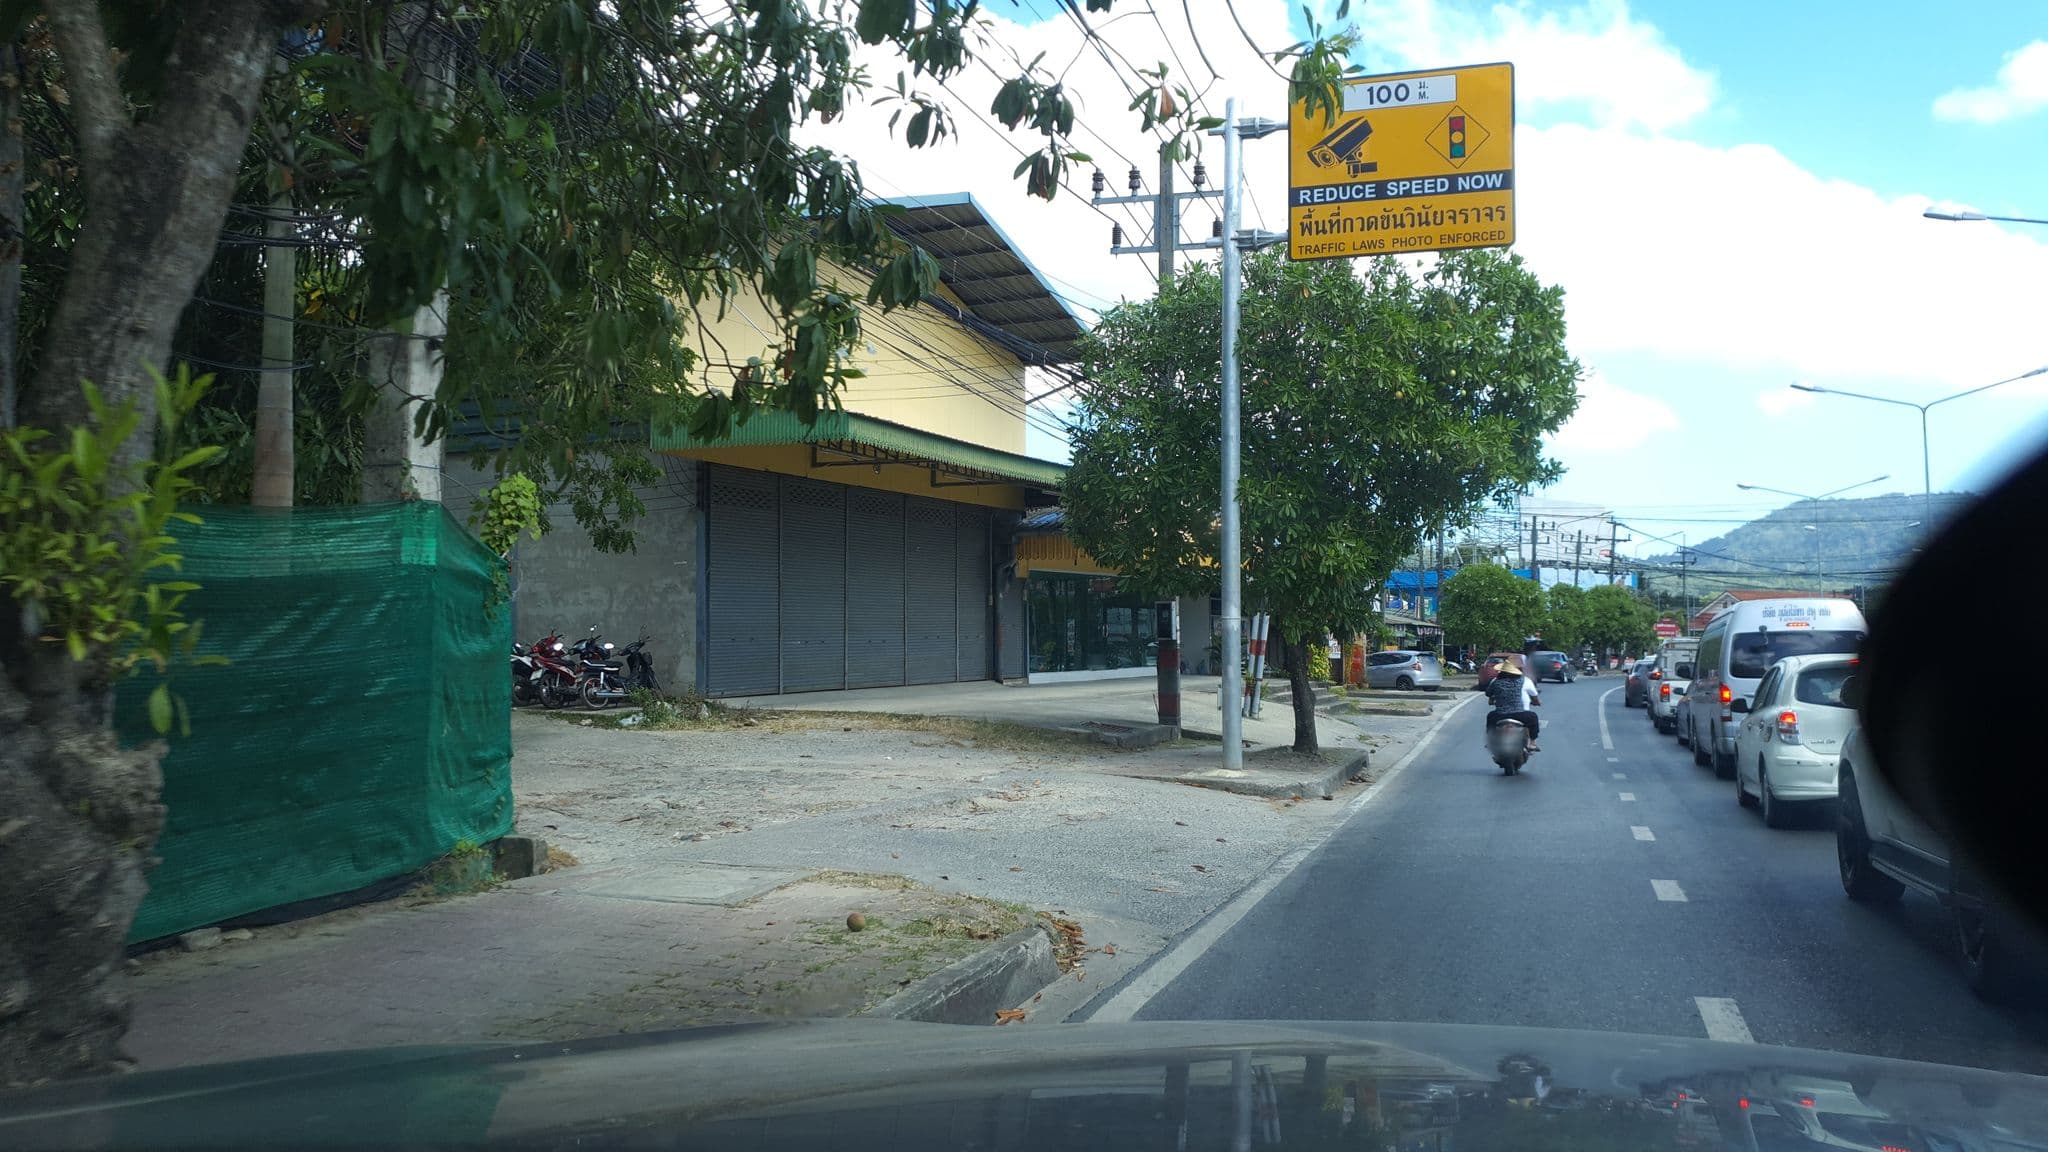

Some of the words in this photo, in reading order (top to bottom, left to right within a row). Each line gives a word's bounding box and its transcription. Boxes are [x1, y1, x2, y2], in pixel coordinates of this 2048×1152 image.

[1367, 83, 1410, 105] 100
[1418, 91, 1429, 100] M.
[1299, 184, 1377, 204] REDUCE
[1387, 178, 1449, 196] SPEED
[1458, 173, 1504, 191] NOW
[1299, 205, 1506, 236] พื้นที่กวดขันวินัยจราจร
[1298, 242, 1346, 255] TRAFFIC
[1353, 239, 1385, 251] LAWS
[1392, 235, 1433, 248] PHOTO
[1440, 230, 1506, 244] ENFORCED
